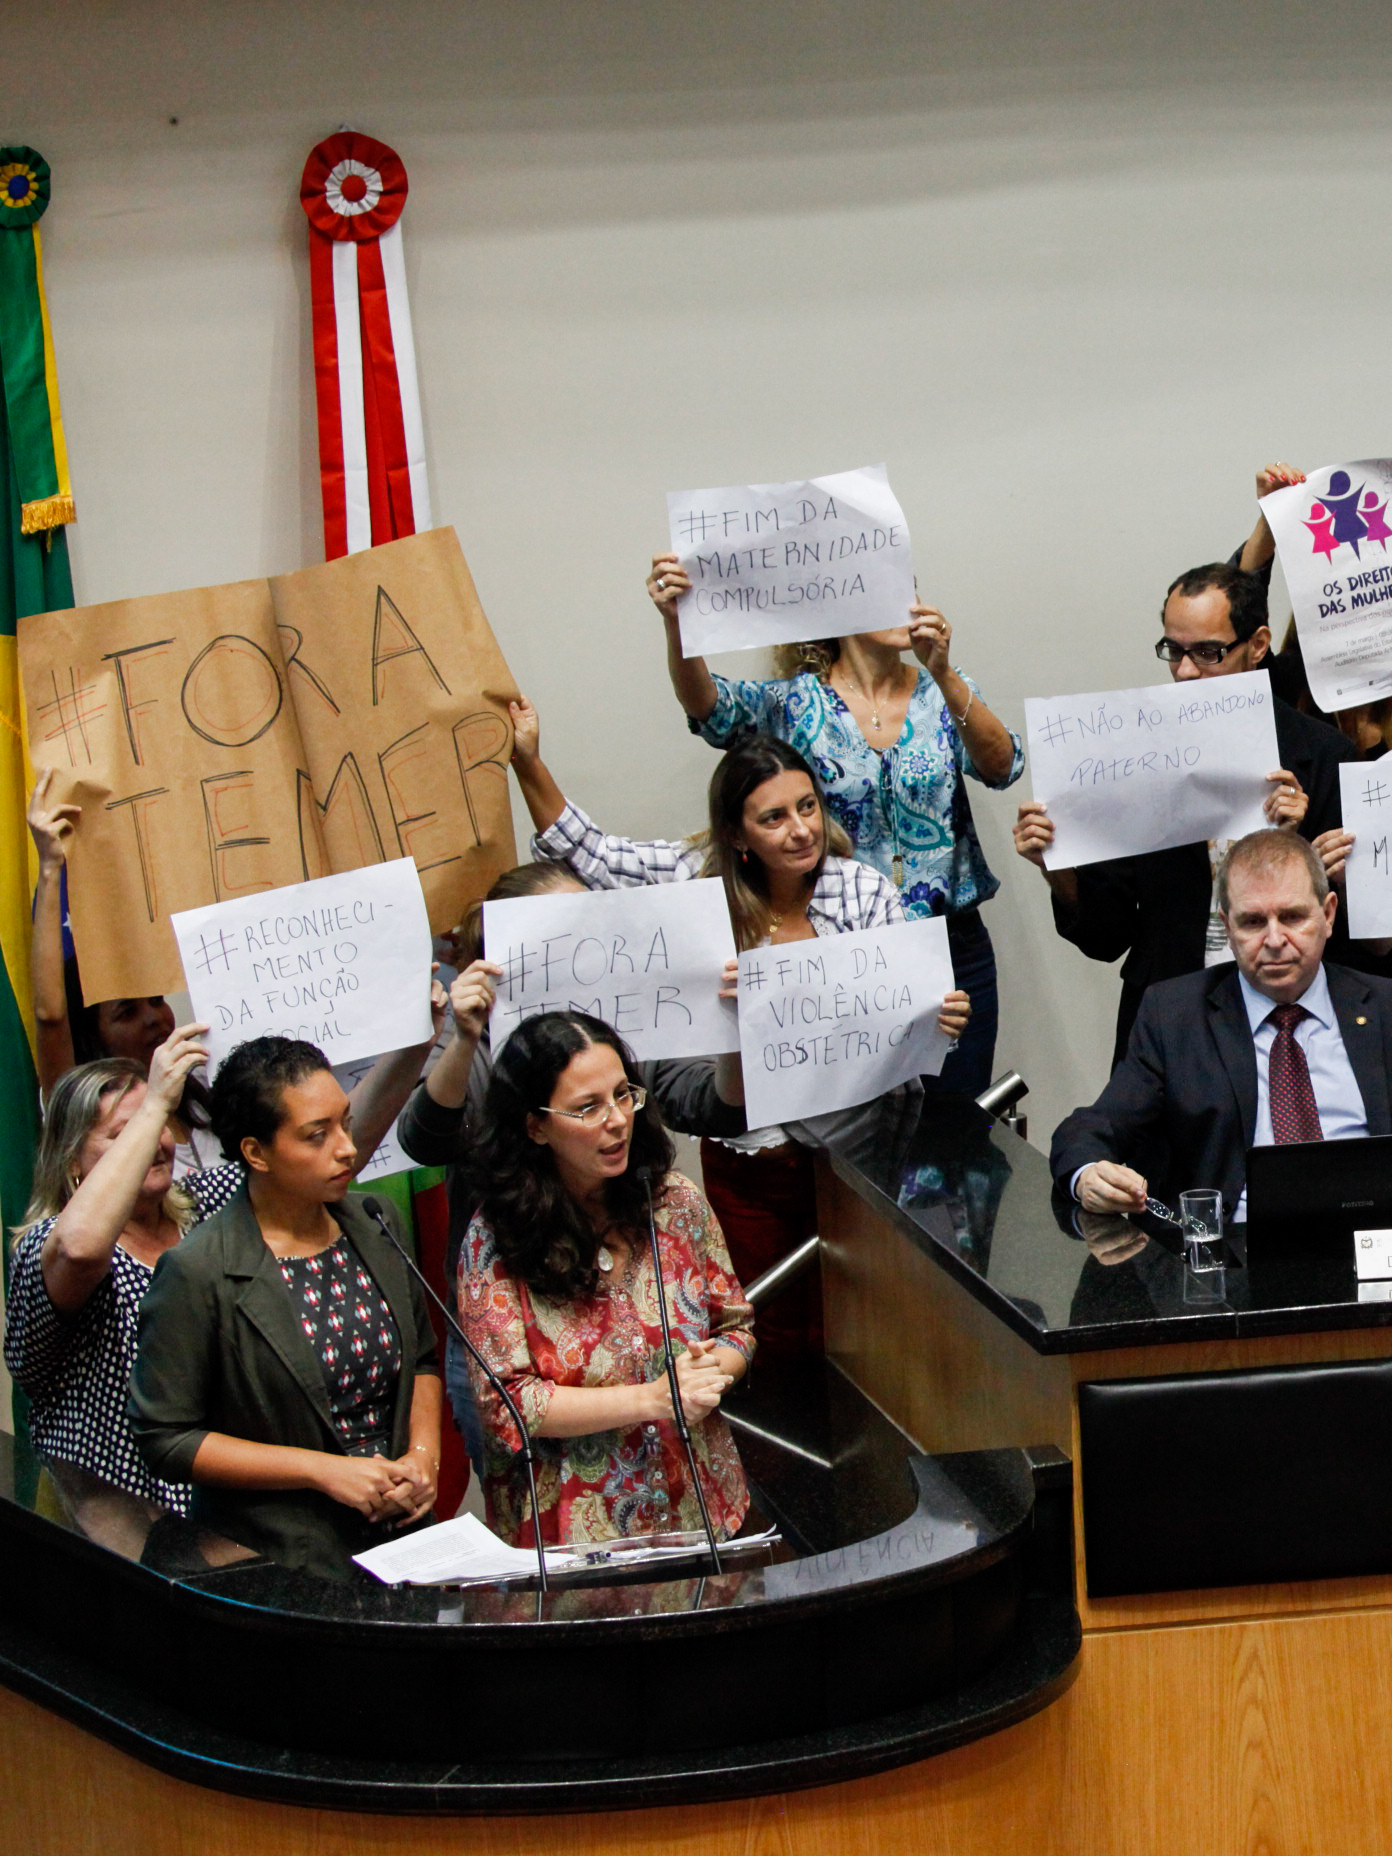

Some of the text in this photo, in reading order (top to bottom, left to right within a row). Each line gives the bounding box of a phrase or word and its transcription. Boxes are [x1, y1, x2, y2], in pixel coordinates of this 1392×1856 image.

[678, 497, 838, 543] #FIM DA
[697, 525, 902, 578] MATERNIDADE
[696, 573, 866, 616] COMPULSÓRIA
[1318, 599, 1346, 618] DAS
[1323, 581, 1342, 597] OS
[37, 585, 452, 767] #FORA
[1038, 689, 1265, 747] #NÃO AO ABANDONO
[1070, 745, 1201, 786] PATERNO
[105, 711, 508, 922] TEMER
[253, 942, 357, 982] MENTO
[496, 927, 668, 1001] #FORA
[850, 946, 888, 979] DA
[215, 968, 359, 1030] DA FUNÇÃO
[770, 983, 912, 1028] VIOLÊNCIA
[763, 1022, 914, 1071] OBSTÉTRICA
